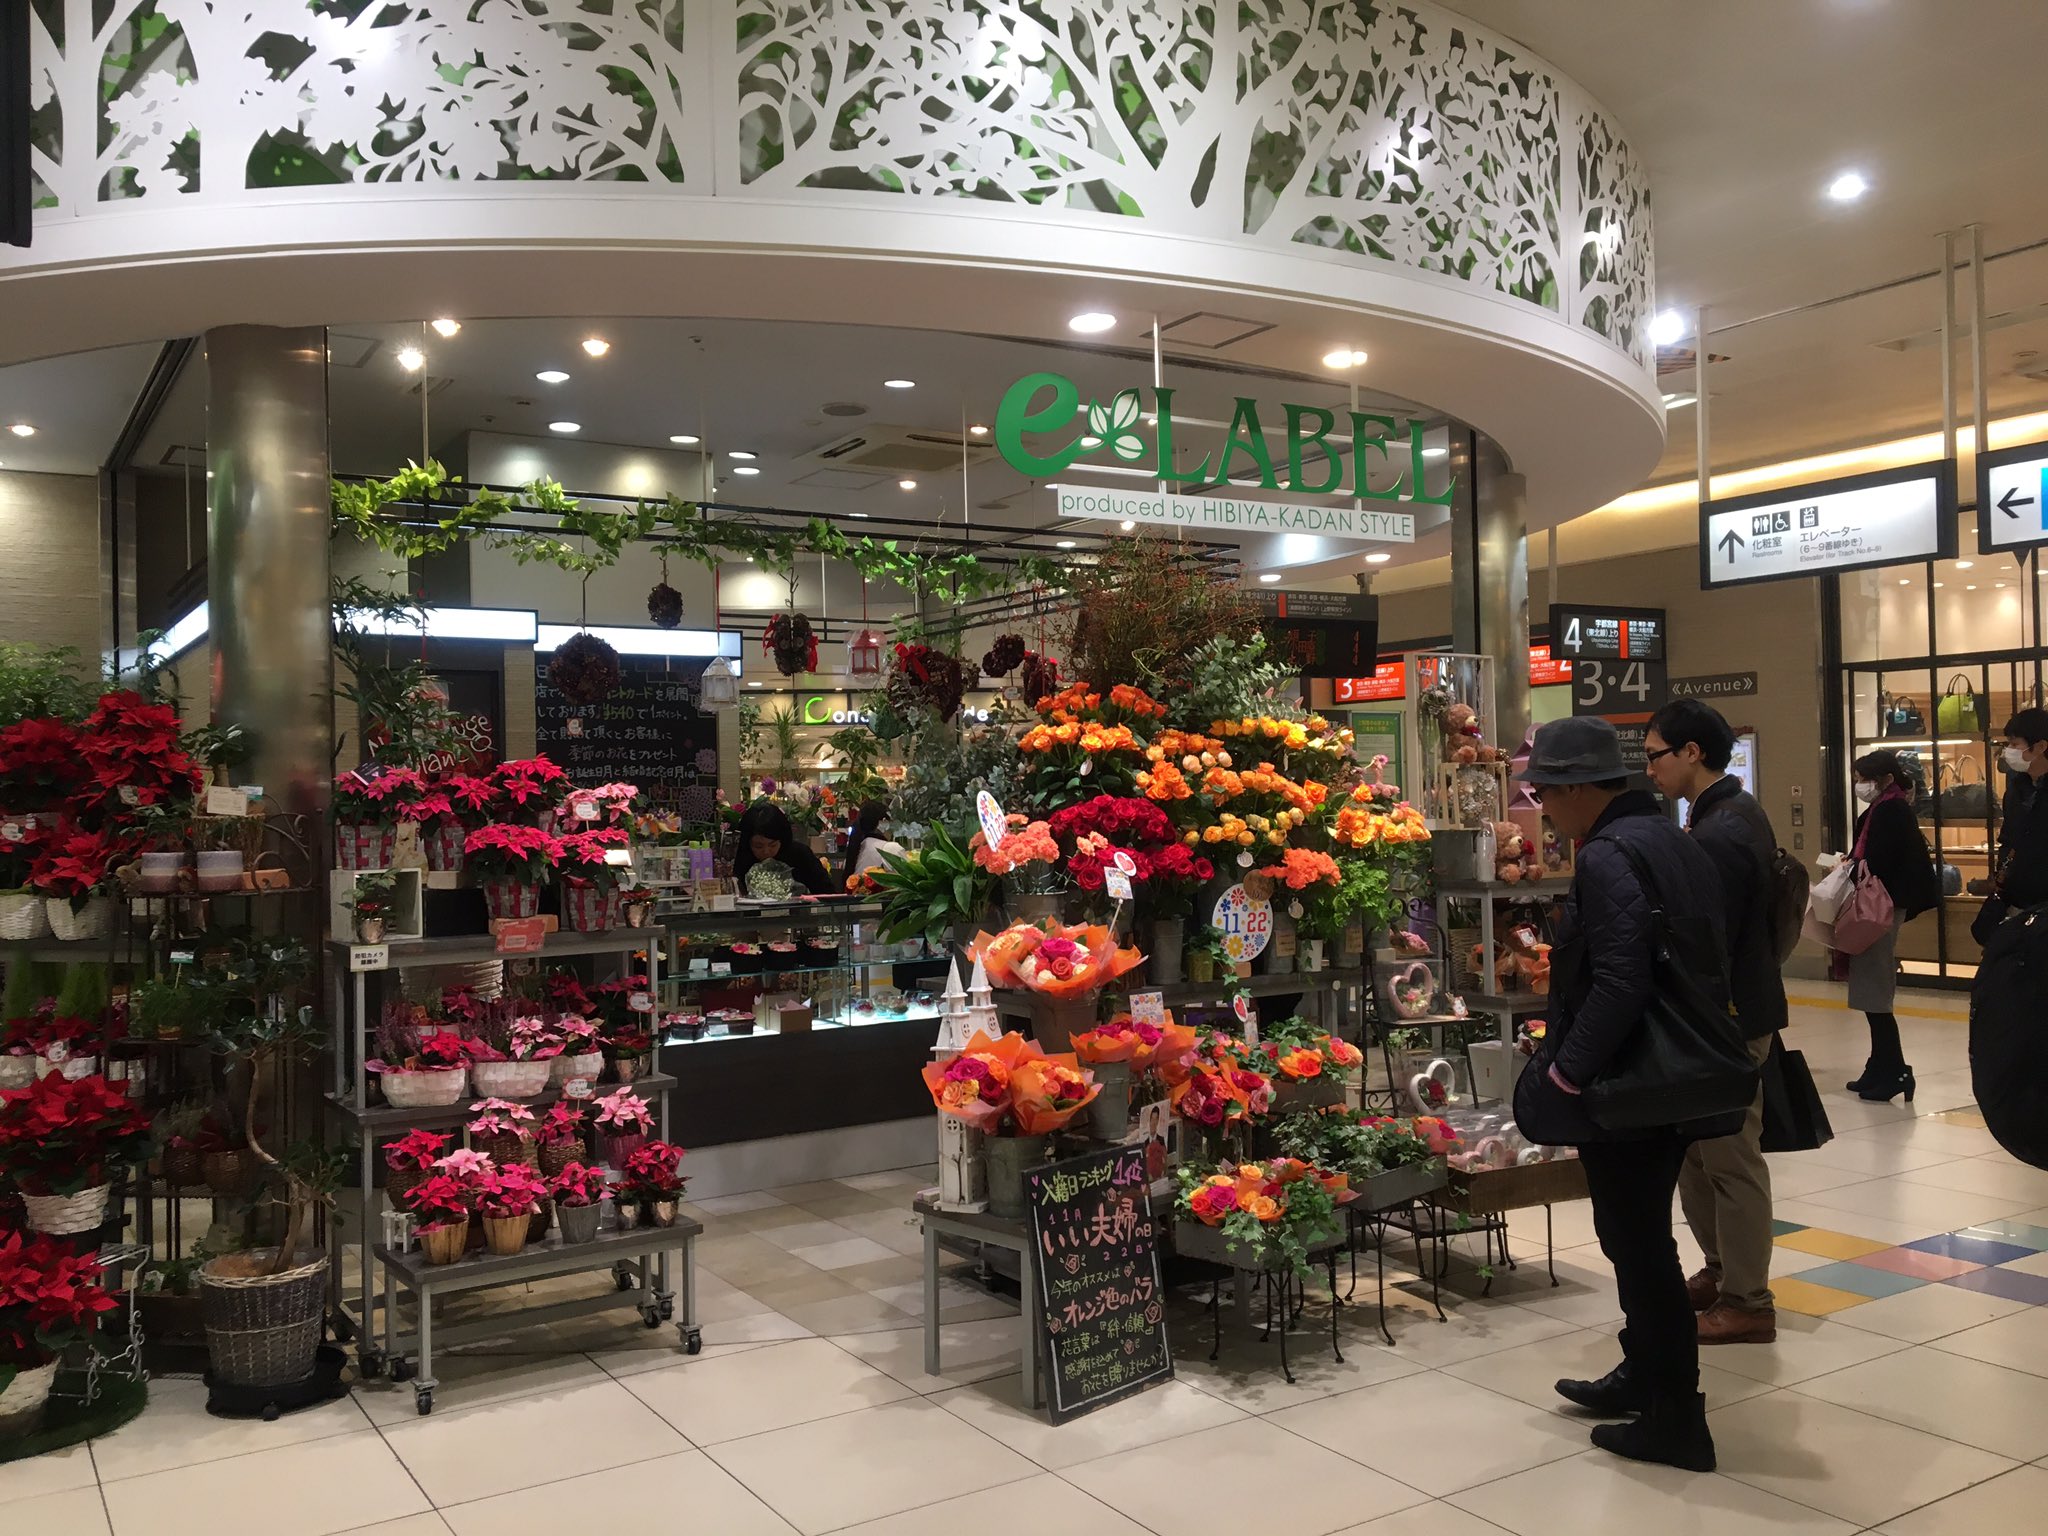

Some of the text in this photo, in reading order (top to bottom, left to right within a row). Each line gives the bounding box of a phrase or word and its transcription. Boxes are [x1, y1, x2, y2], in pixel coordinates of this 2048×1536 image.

[1152, 385, 1456, 507] LABEL
[1061, 493, 1412, 538] produced by HIBIYA-KADAN STYLE
[1752, 536, 1783, 550] 化粧室
[1799, 526, 1862, 543] エレベーター
[1564, 617, 1582, 653] 4
[1223, 911, 1267, 934] 11 22
[1063, 1276, 1153, 1328] オレンジ色のバラ
